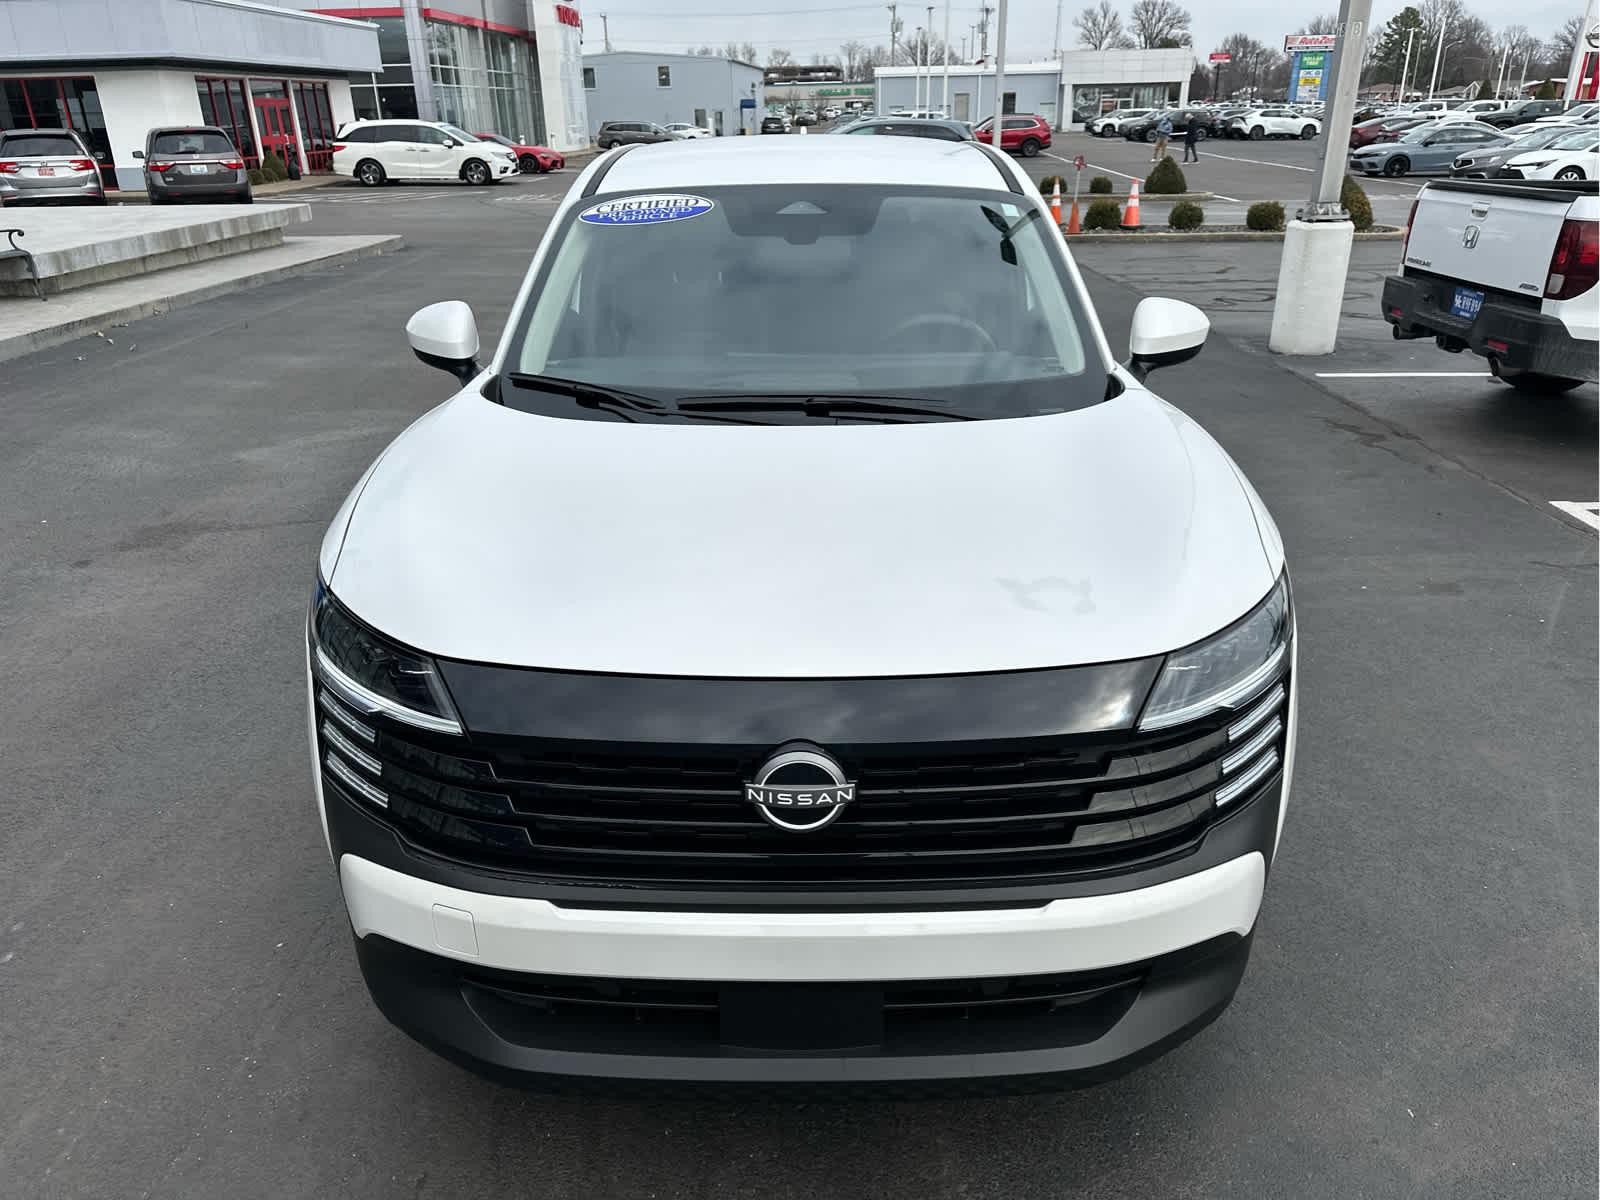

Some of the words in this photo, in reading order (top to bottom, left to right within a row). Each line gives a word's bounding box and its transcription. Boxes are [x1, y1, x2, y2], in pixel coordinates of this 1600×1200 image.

[596, 199, 699, 213] CERTIFIED
[599, 206, 693, 219] PRE-OWNED
[612, 212, 678, 222] VEHICLE
[748, 788, 852, 805] NISSAN
